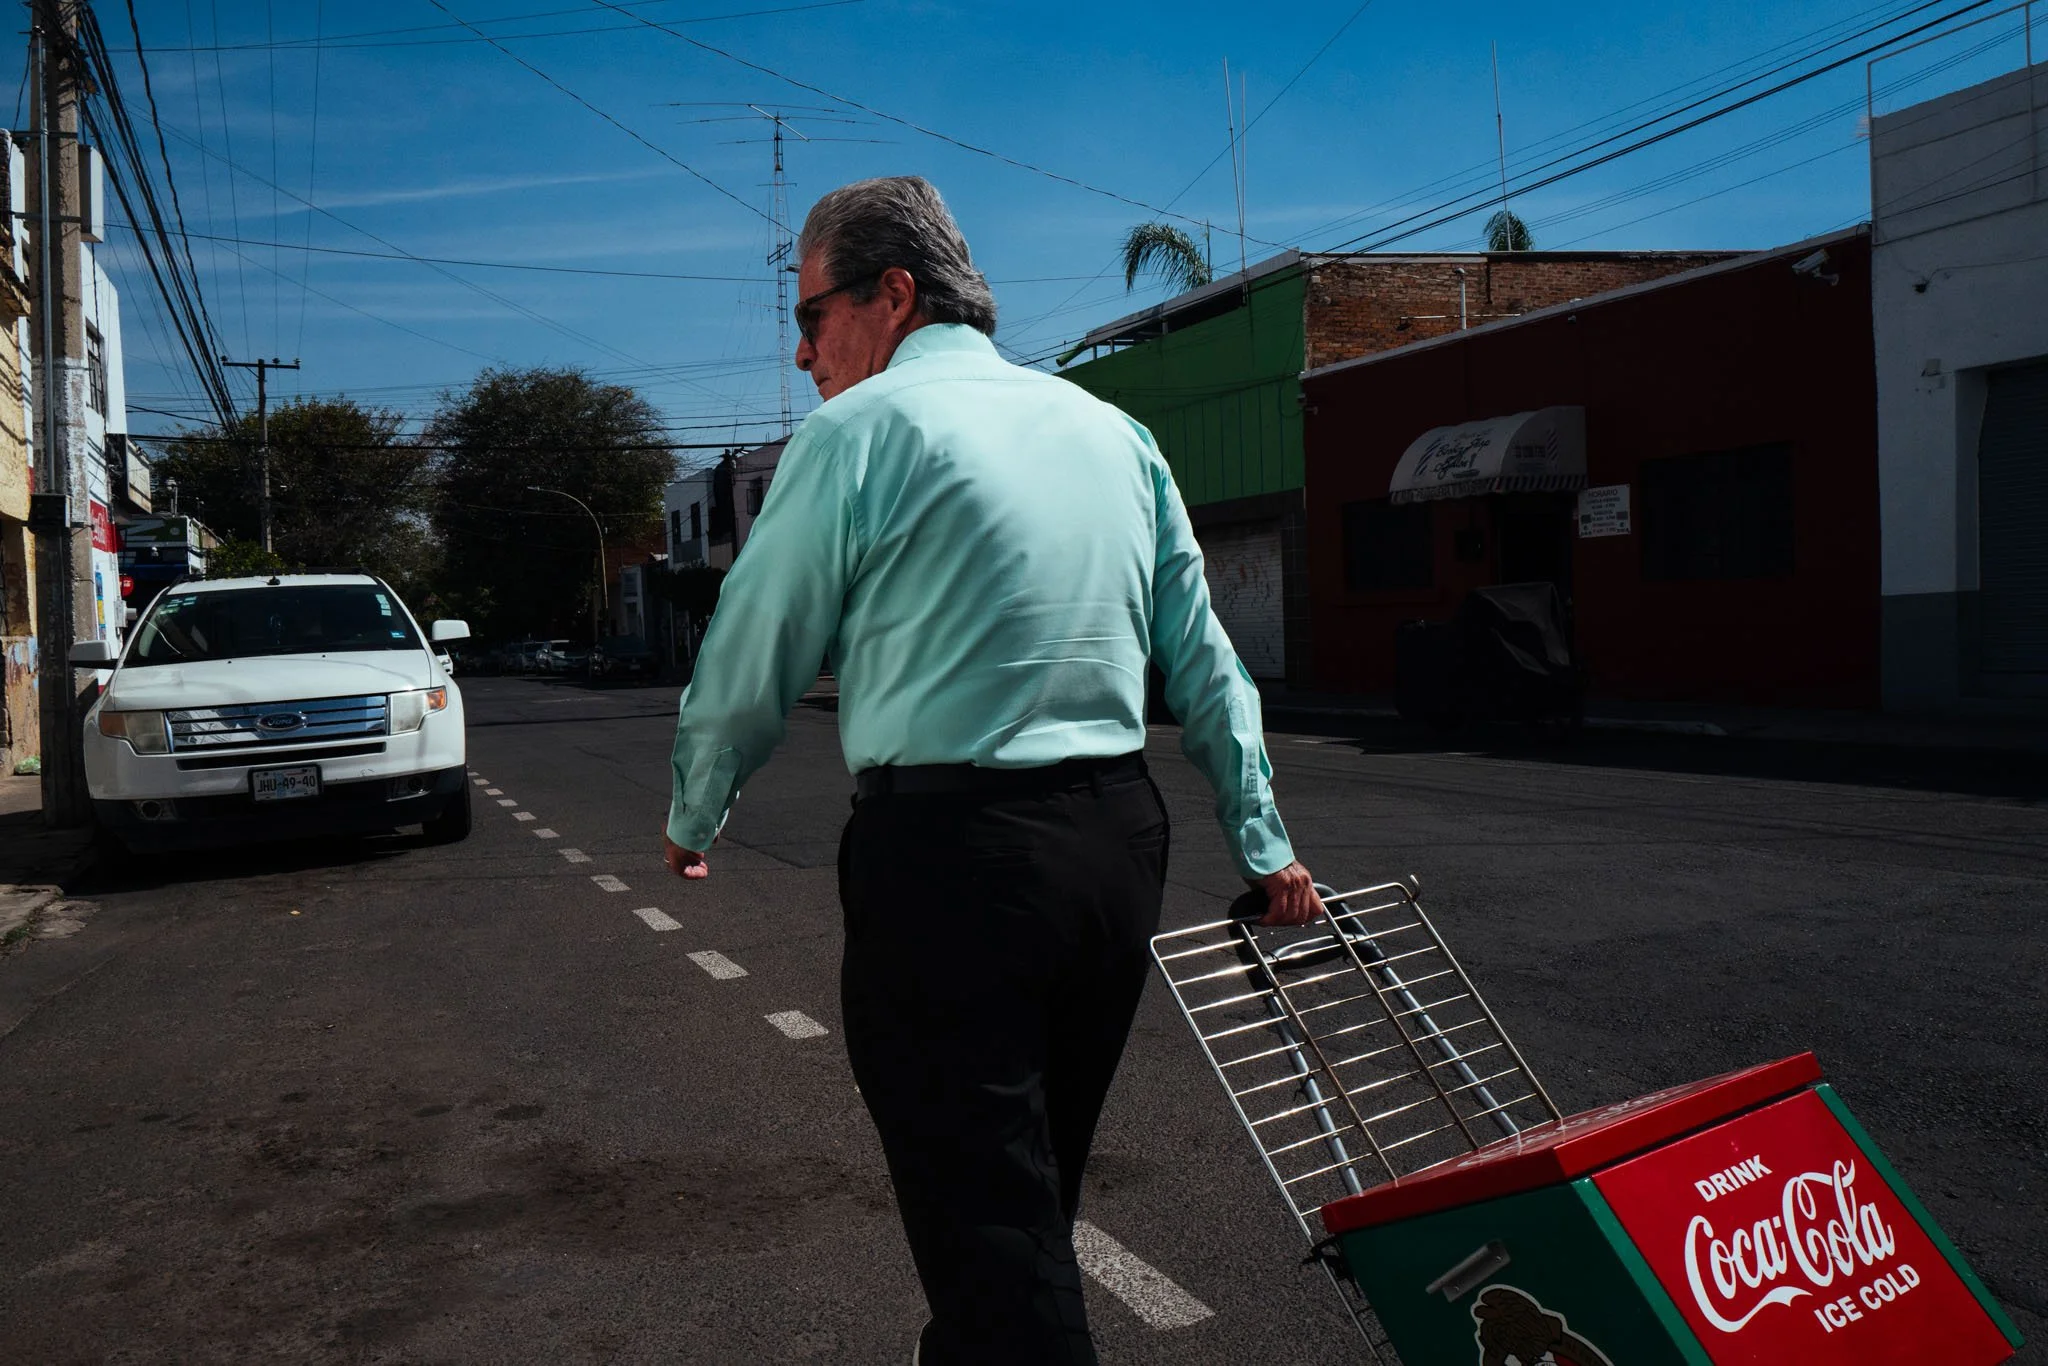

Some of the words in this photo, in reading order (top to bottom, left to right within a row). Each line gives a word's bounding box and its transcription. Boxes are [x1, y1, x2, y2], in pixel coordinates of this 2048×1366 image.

[1588, 489, 1618, 497] HORARIO
[1694, 1154, 1773, 1202] DRINK
[1685, 1159, 1895, 1332] Coca-Cola
[1813, 1296, 1863, 1333] ICE
[1859, 1264, 1920, 1310] COLD
